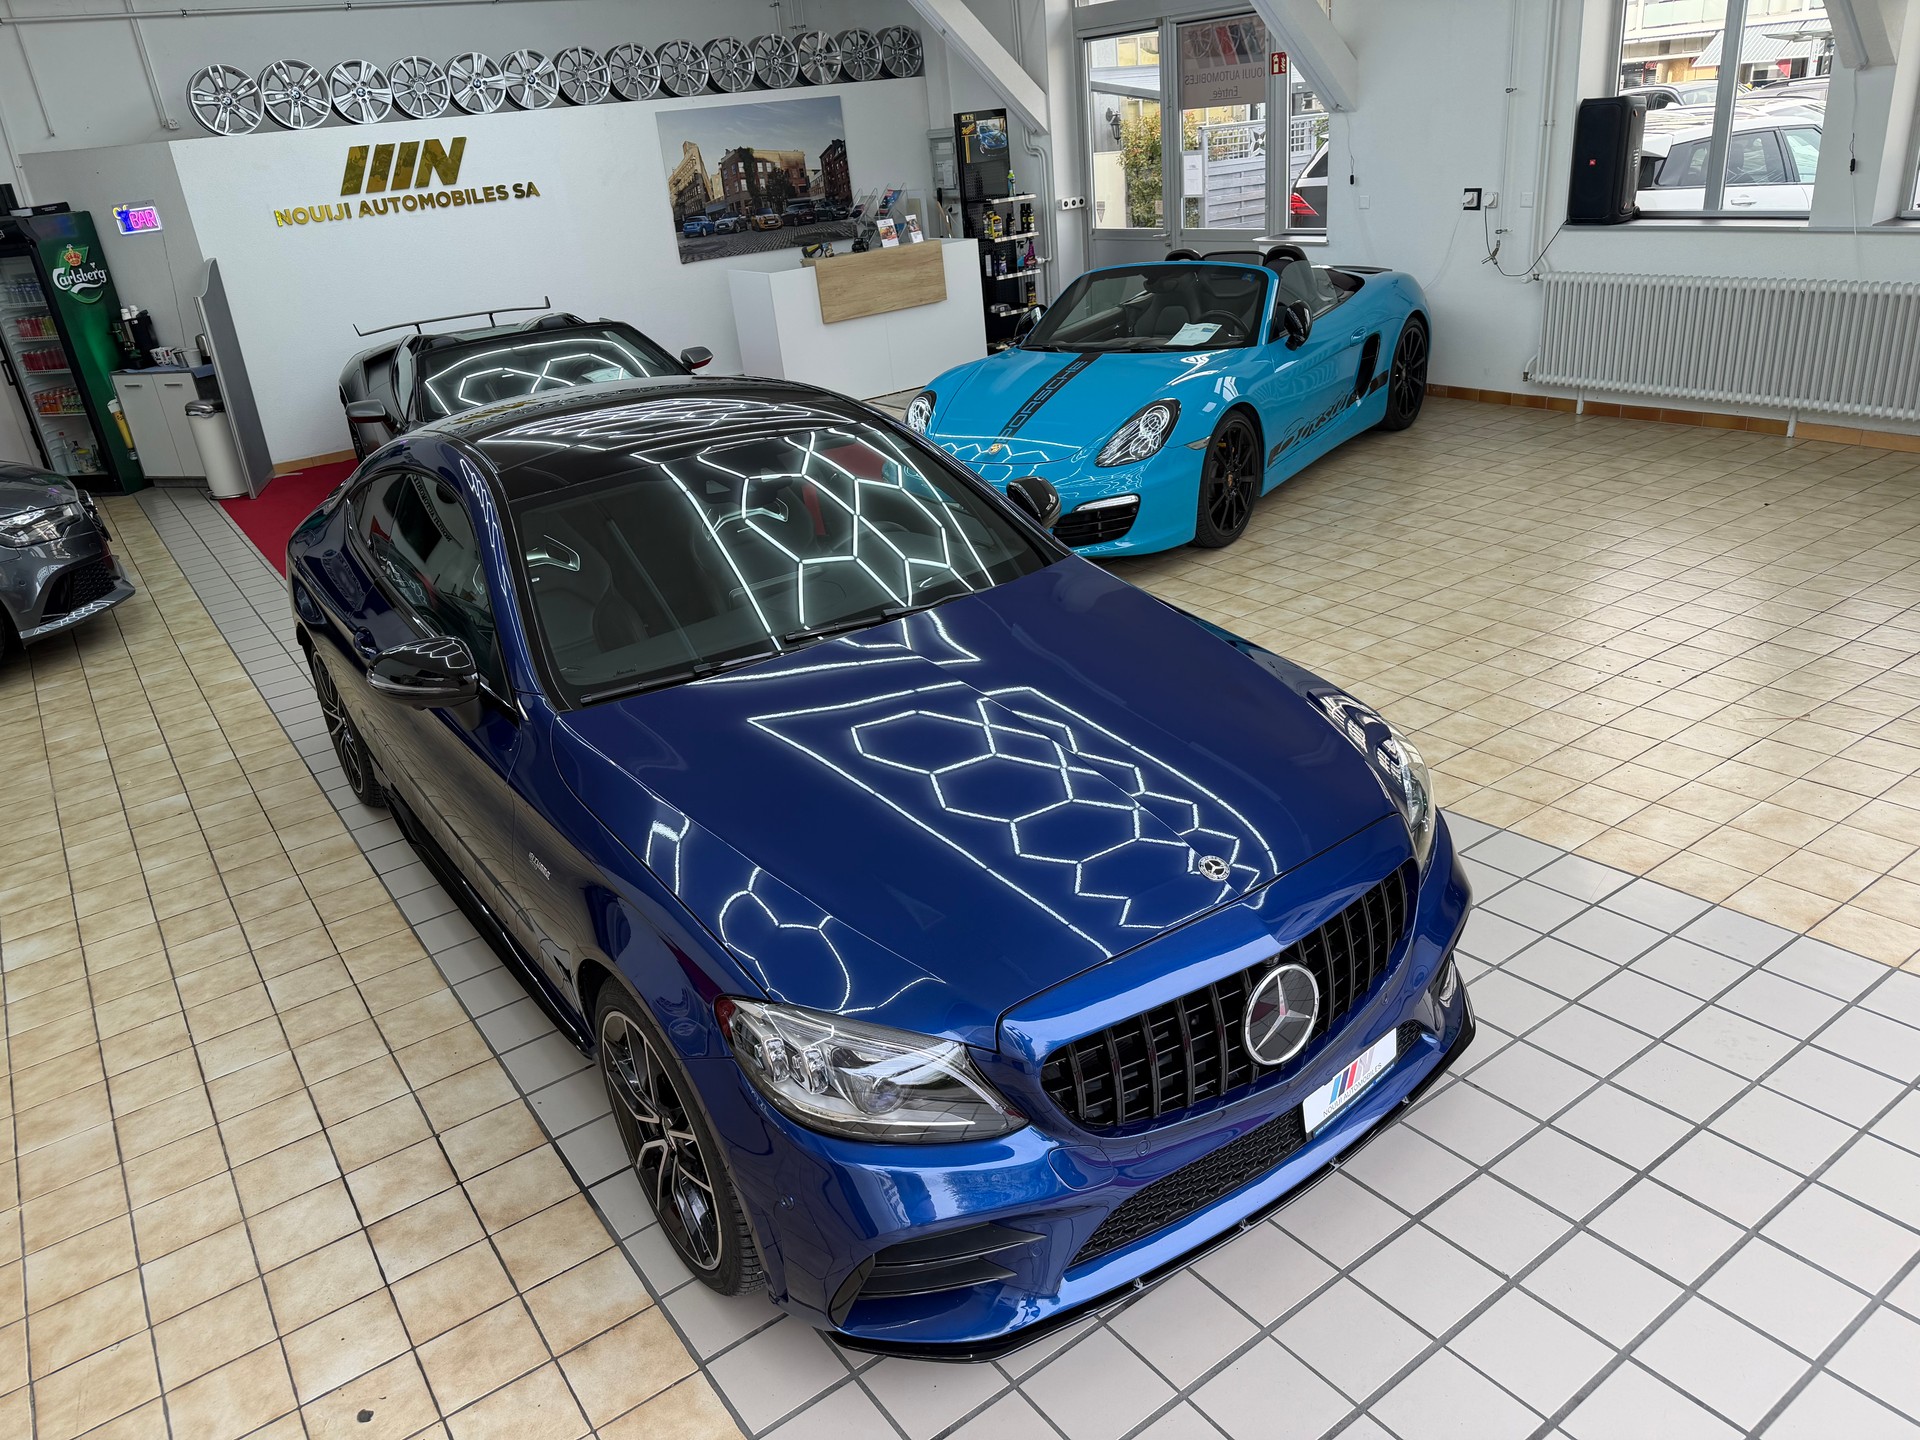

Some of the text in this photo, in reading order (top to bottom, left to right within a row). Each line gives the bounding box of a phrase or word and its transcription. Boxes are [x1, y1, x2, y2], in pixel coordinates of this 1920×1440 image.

[129, 209, 157, 229] BAR
[274, 181, 540, 227] NOUIJI AUTOMOBILES SA
[52, 264, 107, 292] Carlsberg
[996, 361, 1088, 442] PORSCHE
[1343, 1062, 1382, 1101] AUTOMOBILES
